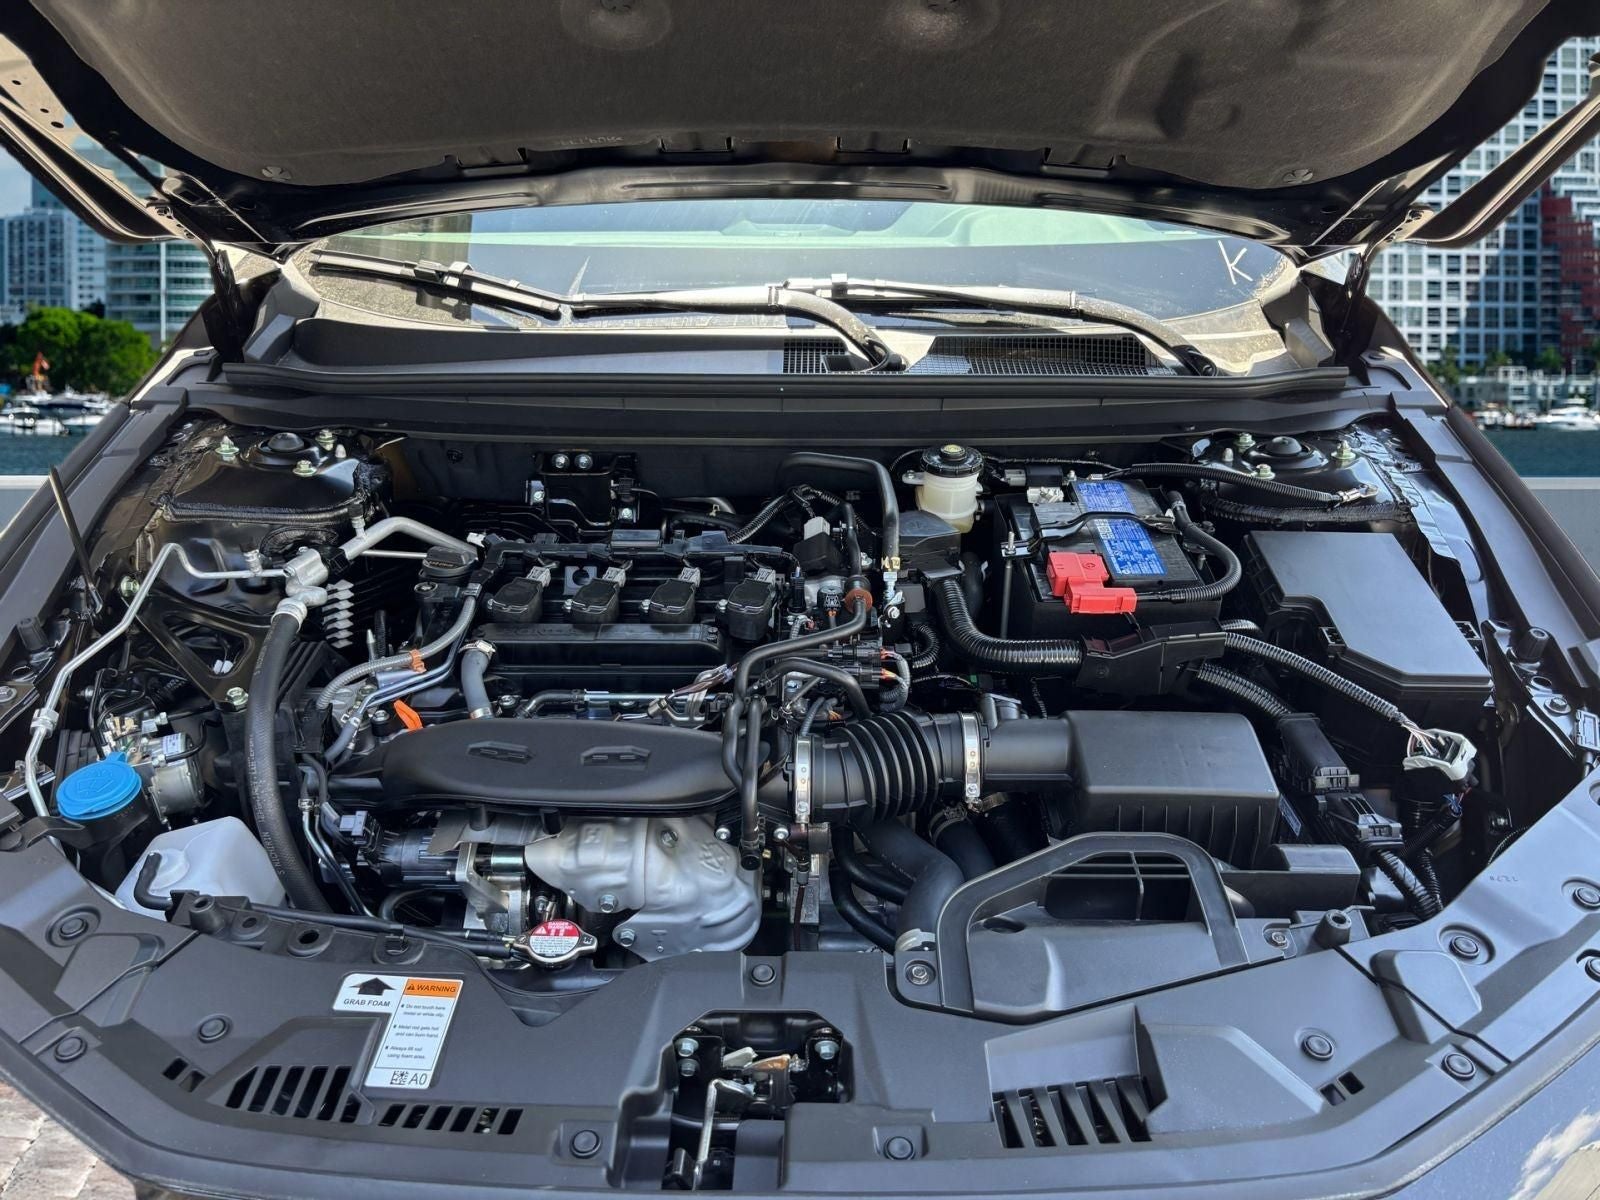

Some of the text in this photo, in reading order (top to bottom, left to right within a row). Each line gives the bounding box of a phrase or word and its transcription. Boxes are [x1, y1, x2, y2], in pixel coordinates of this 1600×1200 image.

[1217, 239, 1254, 285] K
[416, 984, 457, 992] WARNING
[343, 998, 391, 1007] GRAB FOAM
[408, 1073, 428, 1085] A0
